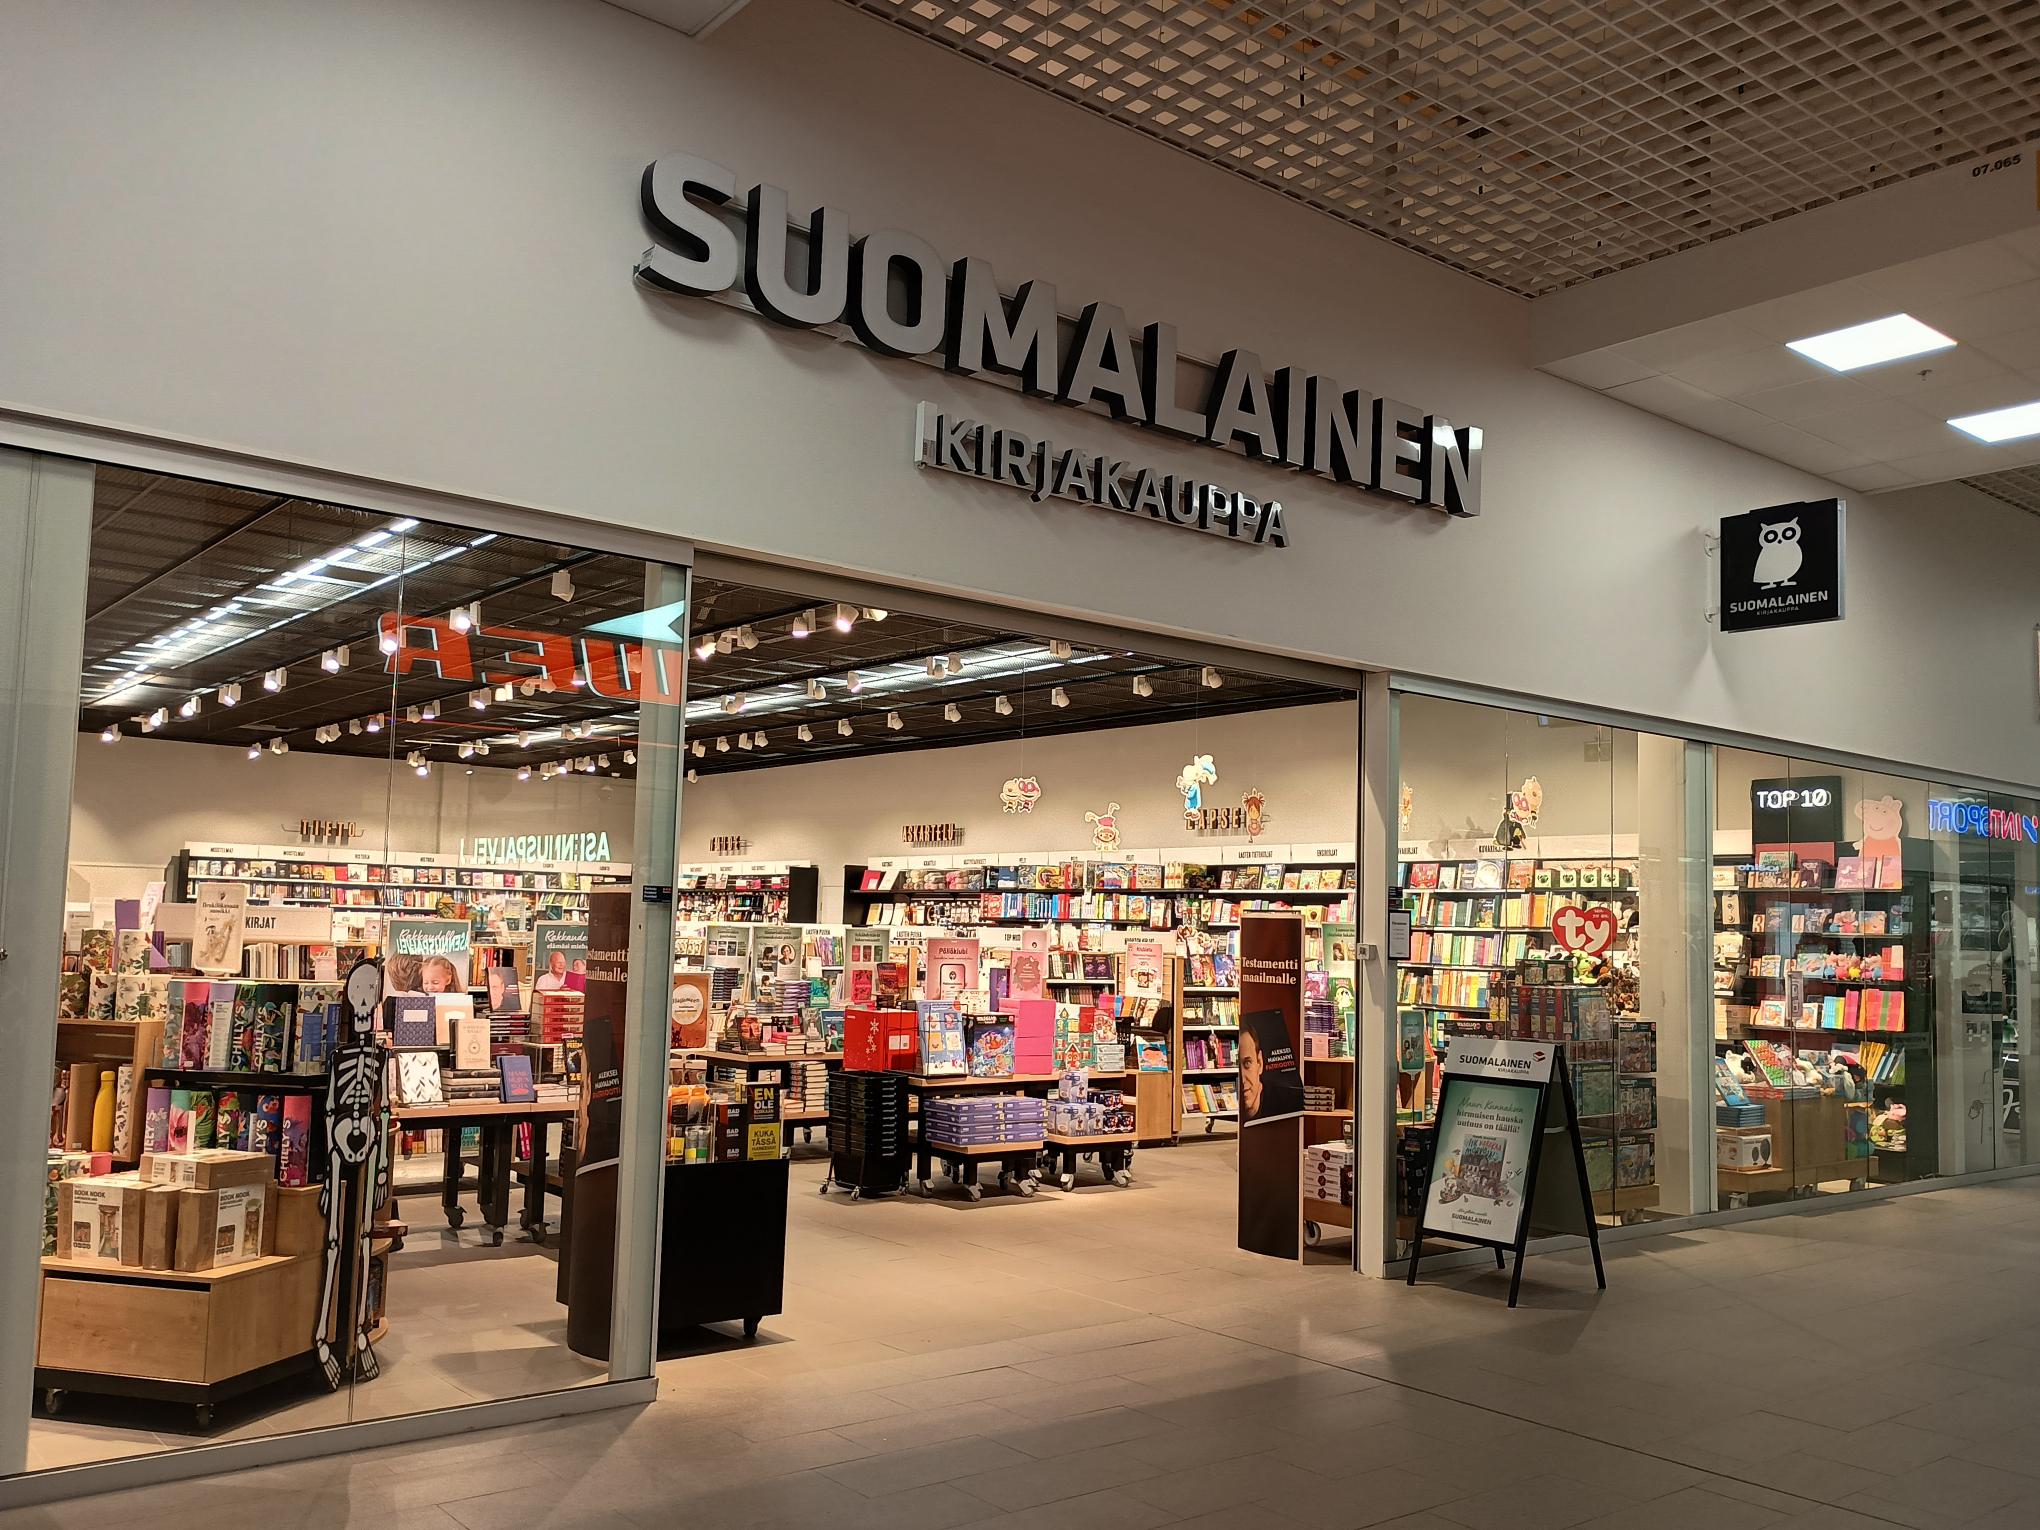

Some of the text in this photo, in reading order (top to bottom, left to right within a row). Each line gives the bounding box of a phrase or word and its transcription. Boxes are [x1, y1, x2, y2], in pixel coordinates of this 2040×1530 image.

[1972, 154, 2022, 177] 07.065
[634, 152, 1483, 518] SUOMALAINEN
[936, 413, 1290, 548] KIRJAKAUPPA
[1730, 590, 1828, 613] SUOMALAINEN
[1757, 606, 1799, 615] KIRJAKAUPPA
[1757, 788, 1828, 808] TOP 10
[1186, 807, 1247, 830] LAPSE
[301, 819, 357, 838] TIETO
[901, 823, 956, 842] ASKARTELU
[245, 916, 276, 929] KIRJAT
[1558, 909, 1609, 953] ty
[938, 947, 968, 955] Pöllöklubi
[1242, 956, 1298, 971] Testamentti
[1242, 972, 1297, 985] maailmalle
[231, 1005, 246, 1066] CHILLY'S
[254, 1006, 267, 1067] CHILLY'S
[1271, 1047, 1292, 1056] ALEKSEI
[1459, 1054, 1532, 1069] SUOMALAINEN
[754, 1087, 774, 1100] EN
[754, 1100, 774, 1109] OLE
[1456, 1108, 1523, 1123] hirmuisen hauska
[754, 1130, 774, 1138] KUKA
[1456, 1120, 1521, 1133] uutuus on täällä!
[279, 1118, 292, 1182] CHILLY'S
[74, 1188, 89, 1197] BOOK
[1451, 1213, 1492, 1225] SUOMALAINEN
